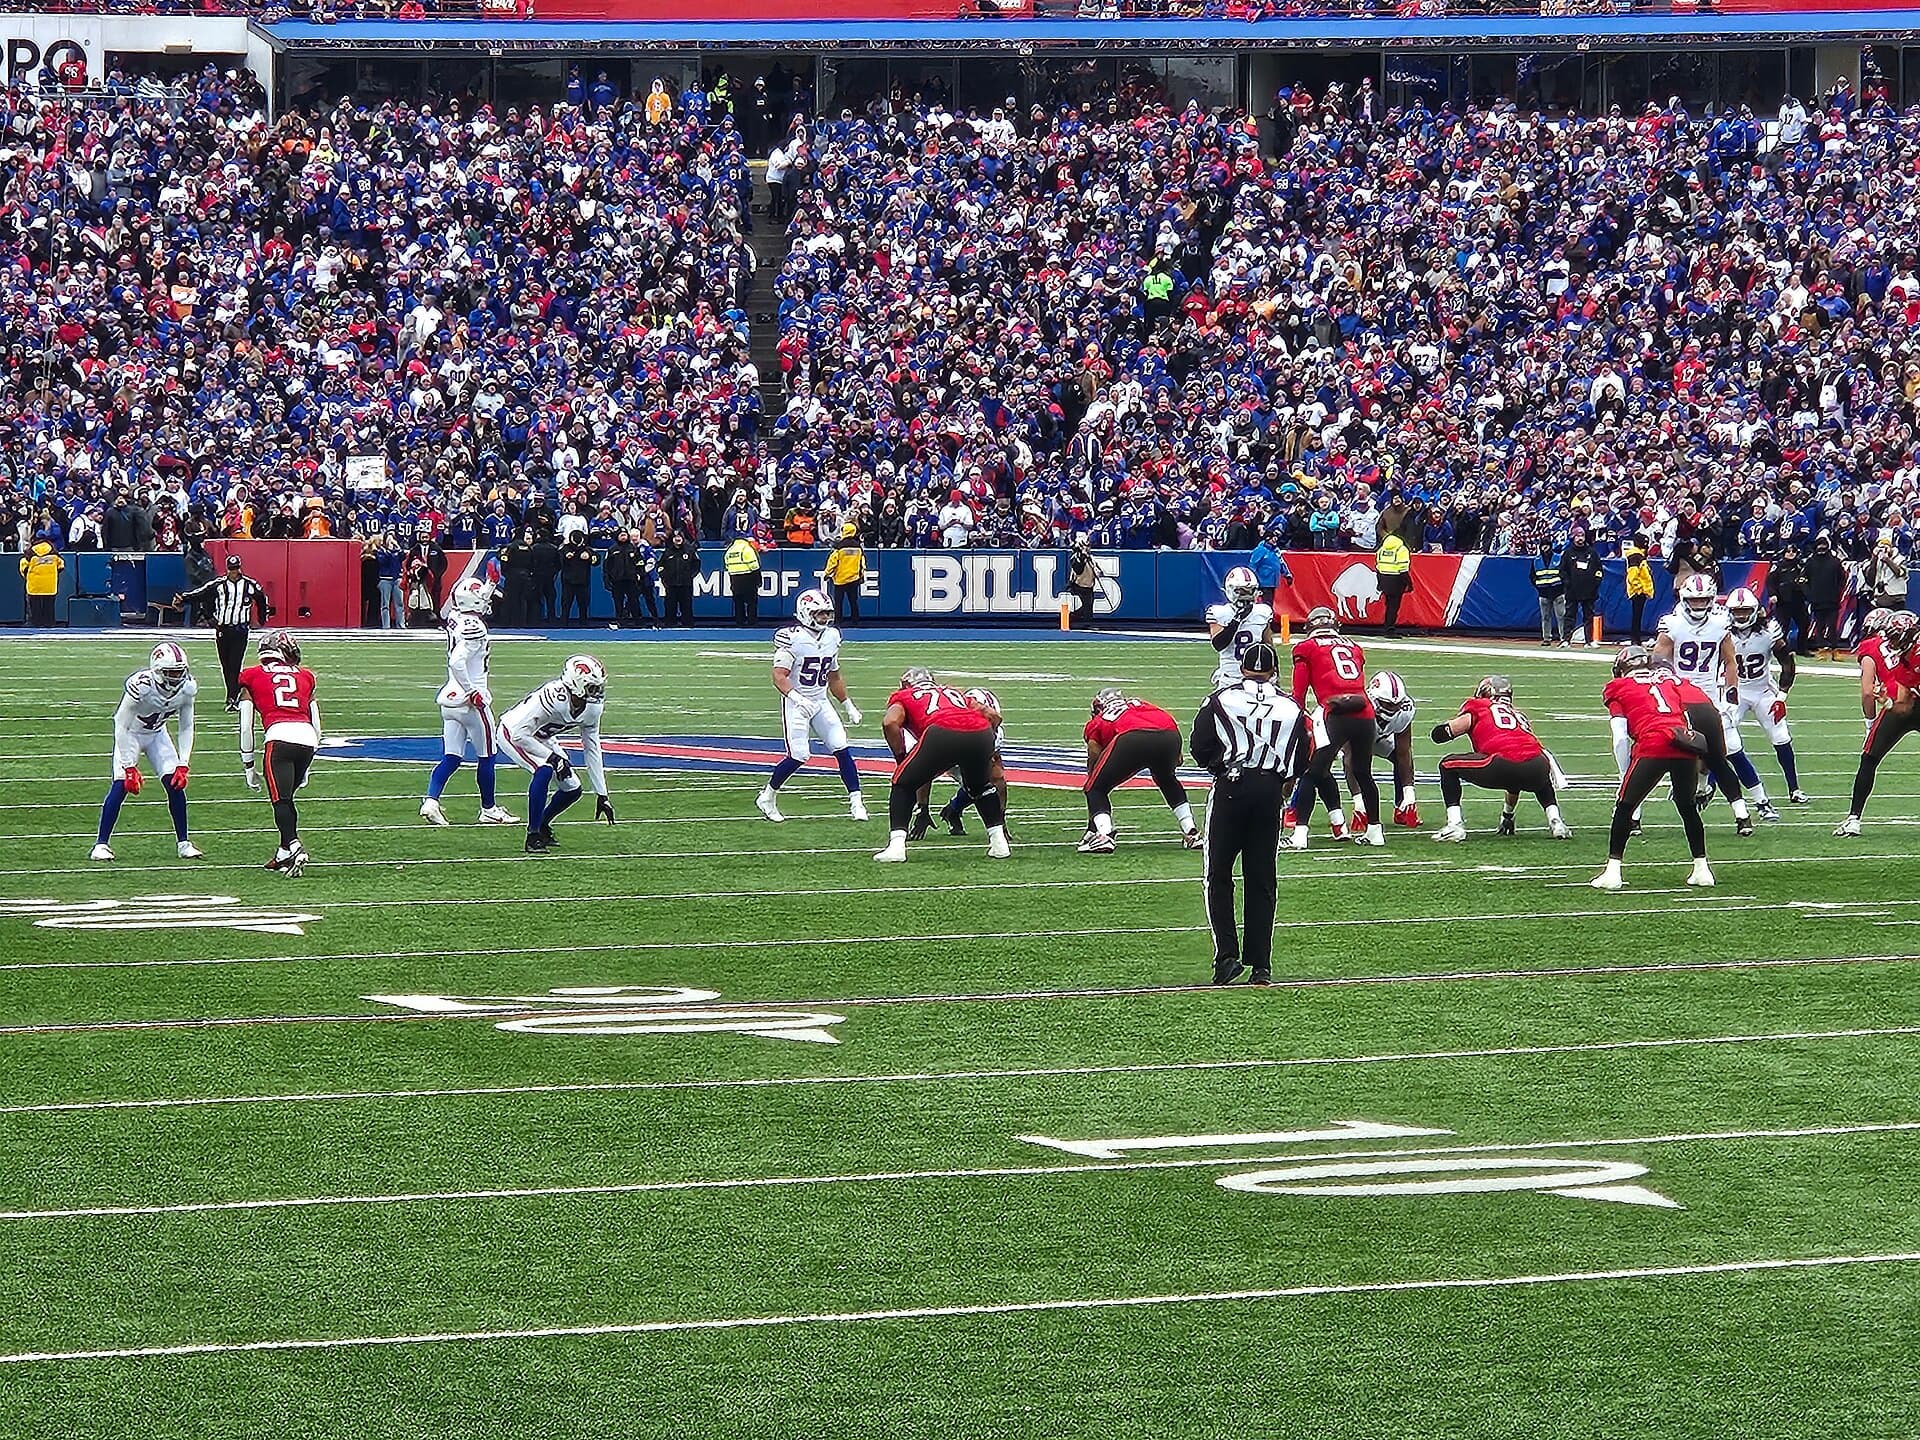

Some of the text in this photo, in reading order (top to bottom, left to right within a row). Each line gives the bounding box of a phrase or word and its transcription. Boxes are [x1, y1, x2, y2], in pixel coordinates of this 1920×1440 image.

[0, 38, 88, 88] PO
[730, 168, 742, 180] 61
[365, 519, 379, 532] 10
[397, 523, 411, 536] 50
[462, 518, 473, 531] 17
[495, 525, 507, 538] 17
[813, 571, 879, 597] TE
[911, 555, 1122, 613] BILLS
[1331, 644, 1361, 680] 6
[1678, 641, 1718, 673] 97
[272, 673, 300, 708] 2
[912, 687, 969, 716] 78
[1649, 685, 1672, 713] 1
[1246, 701, 1274, 718] 77
